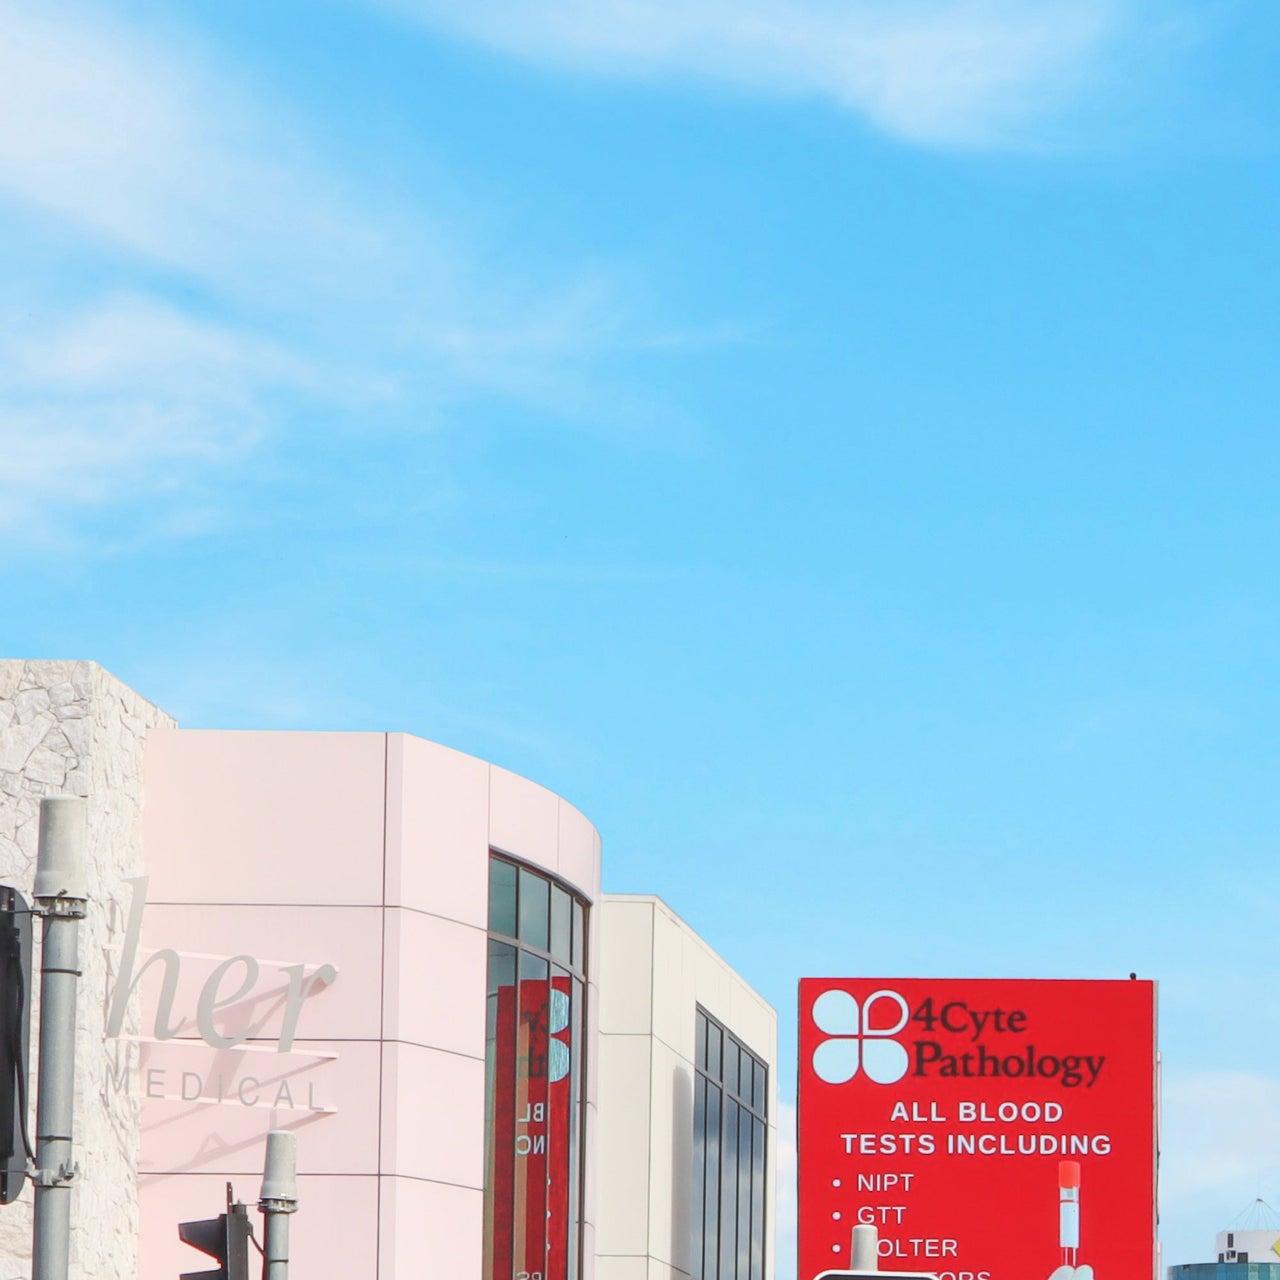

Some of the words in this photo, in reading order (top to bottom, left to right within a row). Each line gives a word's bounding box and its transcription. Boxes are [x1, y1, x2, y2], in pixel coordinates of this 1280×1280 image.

[107, 876, 337, 1053] her
[912, 997, 1028, 1042] 4Cyte
[912, 1040, 1106, 1088] Pathology
[105, 1063, 325, 1111] MEDICAL
[890, 1101, 946, 1122] ALL
[958, 1101, 1063, 1123] BLOOD
[841, 1134, 936, 1154] TESTS
[948, 1134, 1111, 1155] INCLUDING
[857, 1173, 914, 1192] NIPT
[857, 1206, 907, 1224] GTT
[876, 1238, 958, 1257] OLTER
